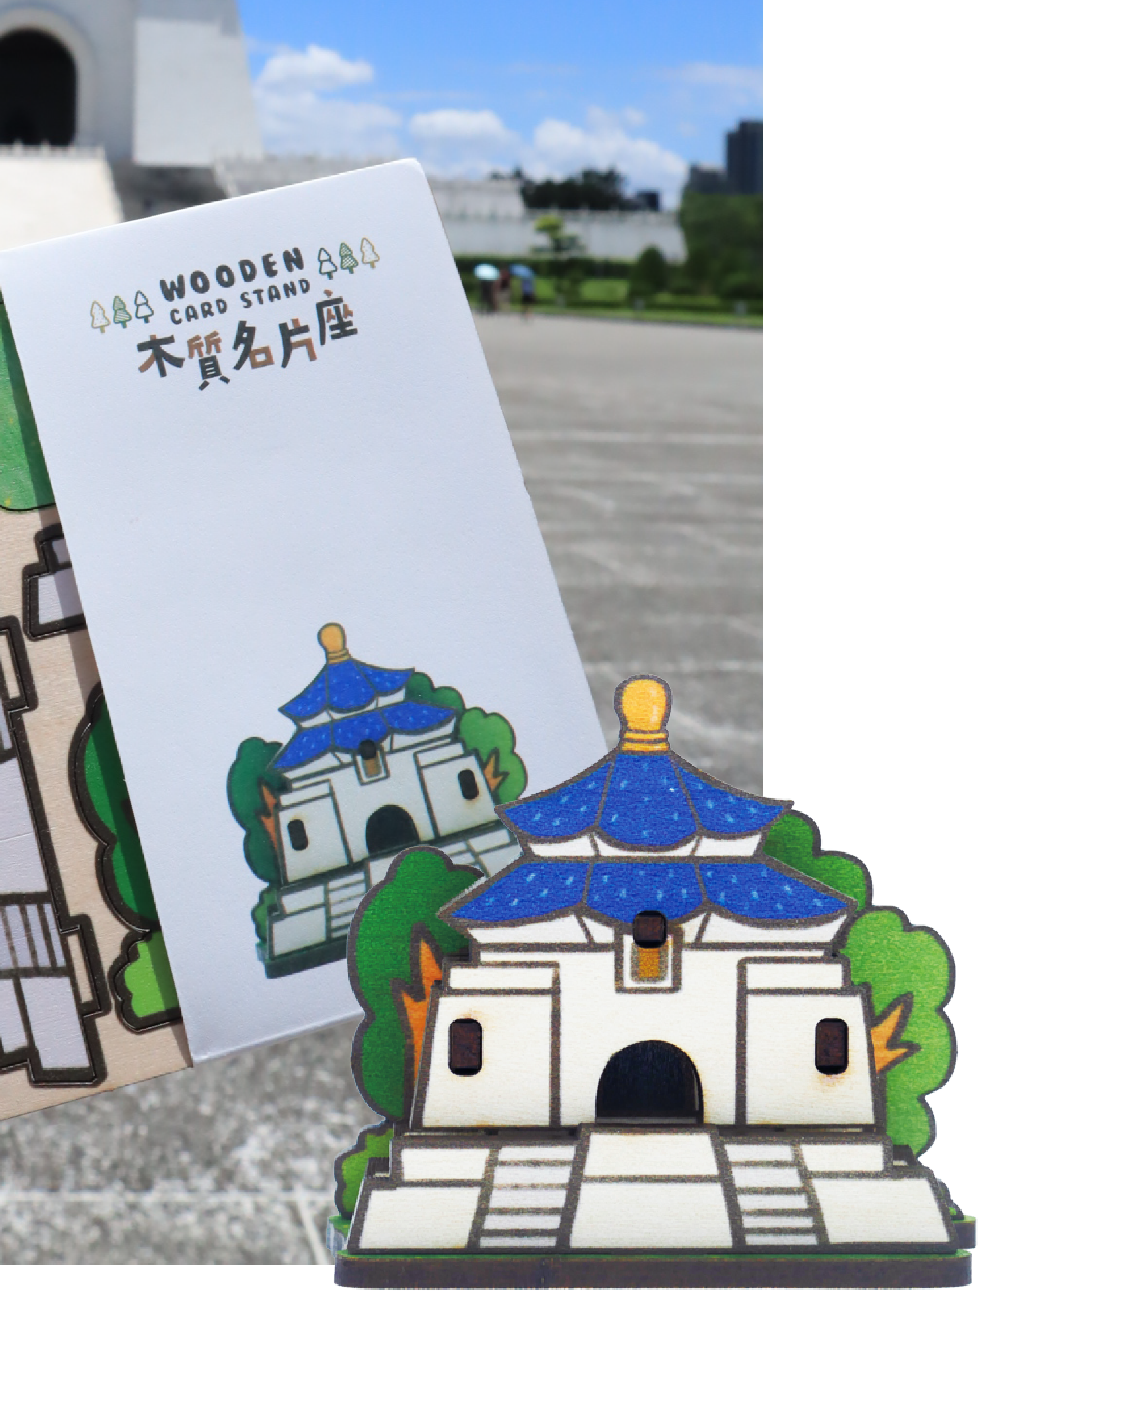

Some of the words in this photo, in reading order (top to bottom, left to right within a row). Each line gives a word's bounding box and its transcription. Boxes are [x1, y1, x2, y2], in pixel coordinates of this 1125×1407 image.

[159, 247, 305, 302] WOODEN
[170, 298, 228, 325] CARD
[240, 278, 311, 308] STAND
[136, 289, 359, 391] 木質名片座
